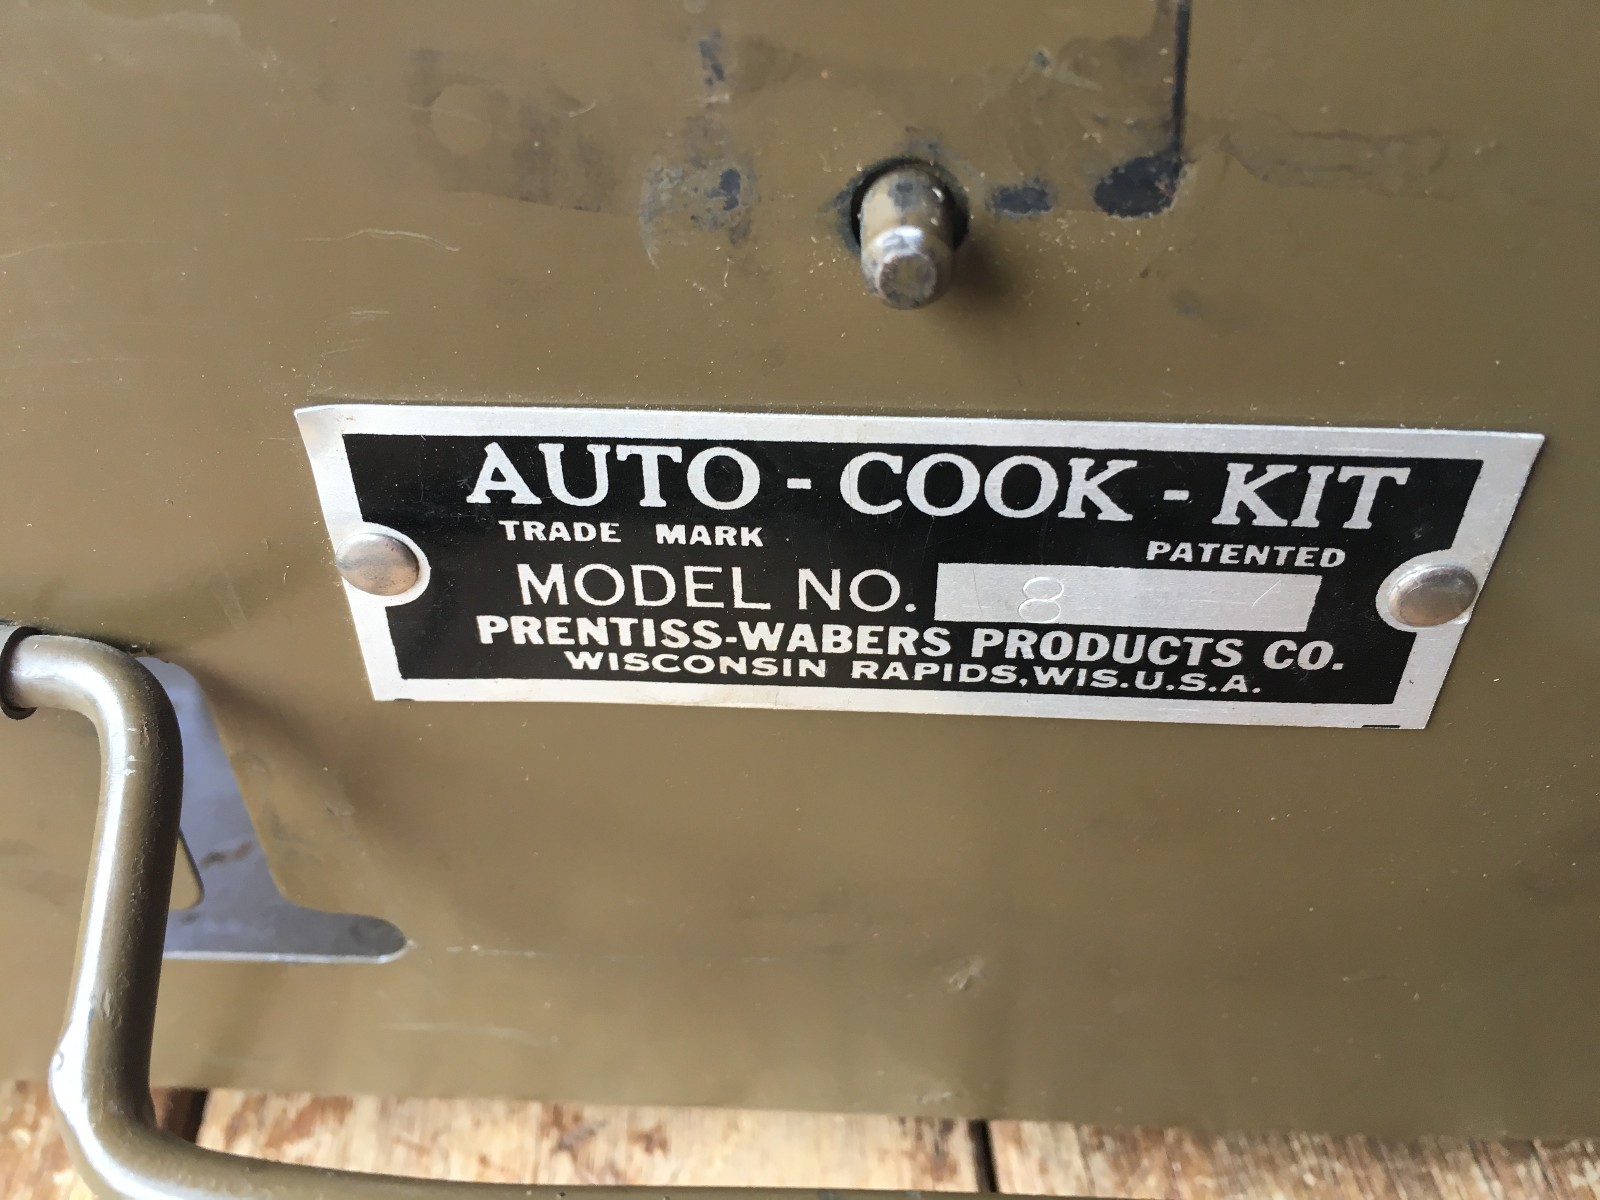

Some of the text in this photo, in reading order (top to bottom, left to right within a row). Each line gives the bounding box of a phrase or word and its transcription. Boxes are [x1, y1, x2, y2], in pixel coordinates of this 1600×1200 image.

[466, 442, 760, 510] AUTO
[840, 452, 1137, 521] COOK
[1212, 463, 1410, 529] KIT
[498, 521, 763, 547] TRADE MARK
[1146, 541, 1345, 567] PATENTED
[517, 564, 1065, 624] MODEL NO. 8
[476, 615, 1343, 670] PRENTISS-WABERS PRODUCTS CO.
[564, 651, 825, 677] WISCONSIN
